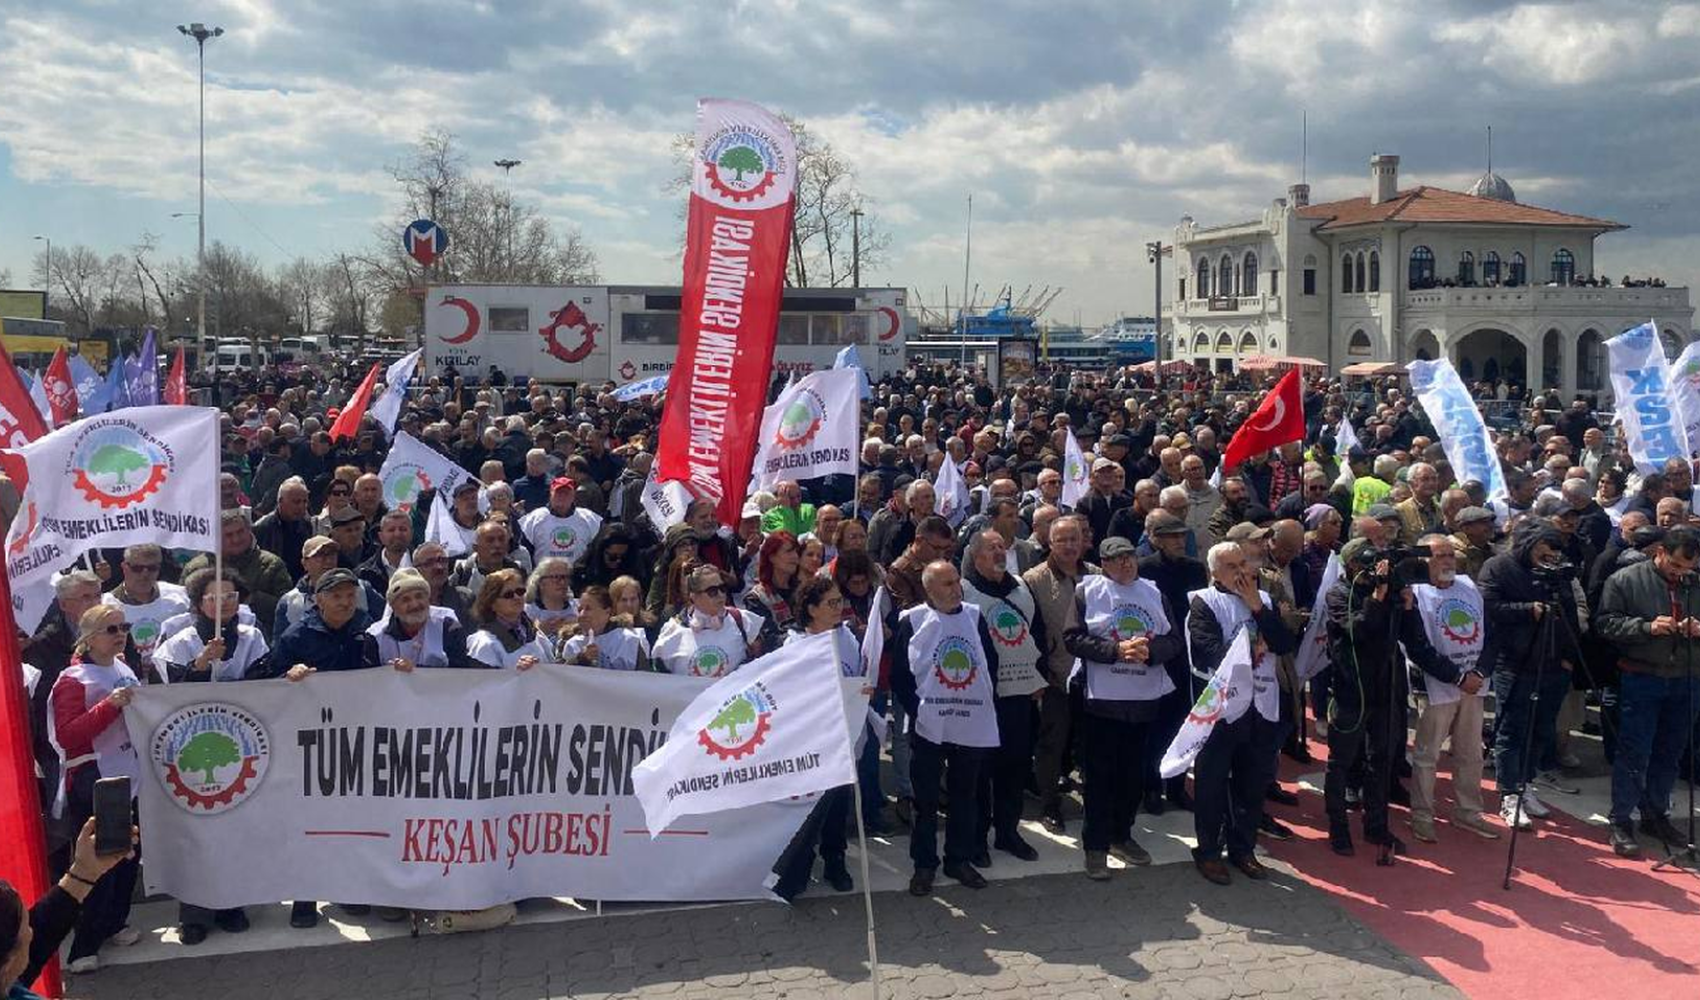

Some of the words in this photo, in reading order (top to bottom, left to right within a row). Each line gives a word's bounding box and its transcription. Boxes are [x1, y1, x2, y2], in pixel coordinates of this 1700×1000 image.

[152, 508, 211, 537] SENDİKASI
[297, 706, 366, 797] TÜM
[372, 699, 563, 801] EMEKLİLERİN
[566, 707, 669, 796] SENDİ
[400, 817, 501, 878] KEŞAN
[506, 803, 613, 871] ŞUBESİ
